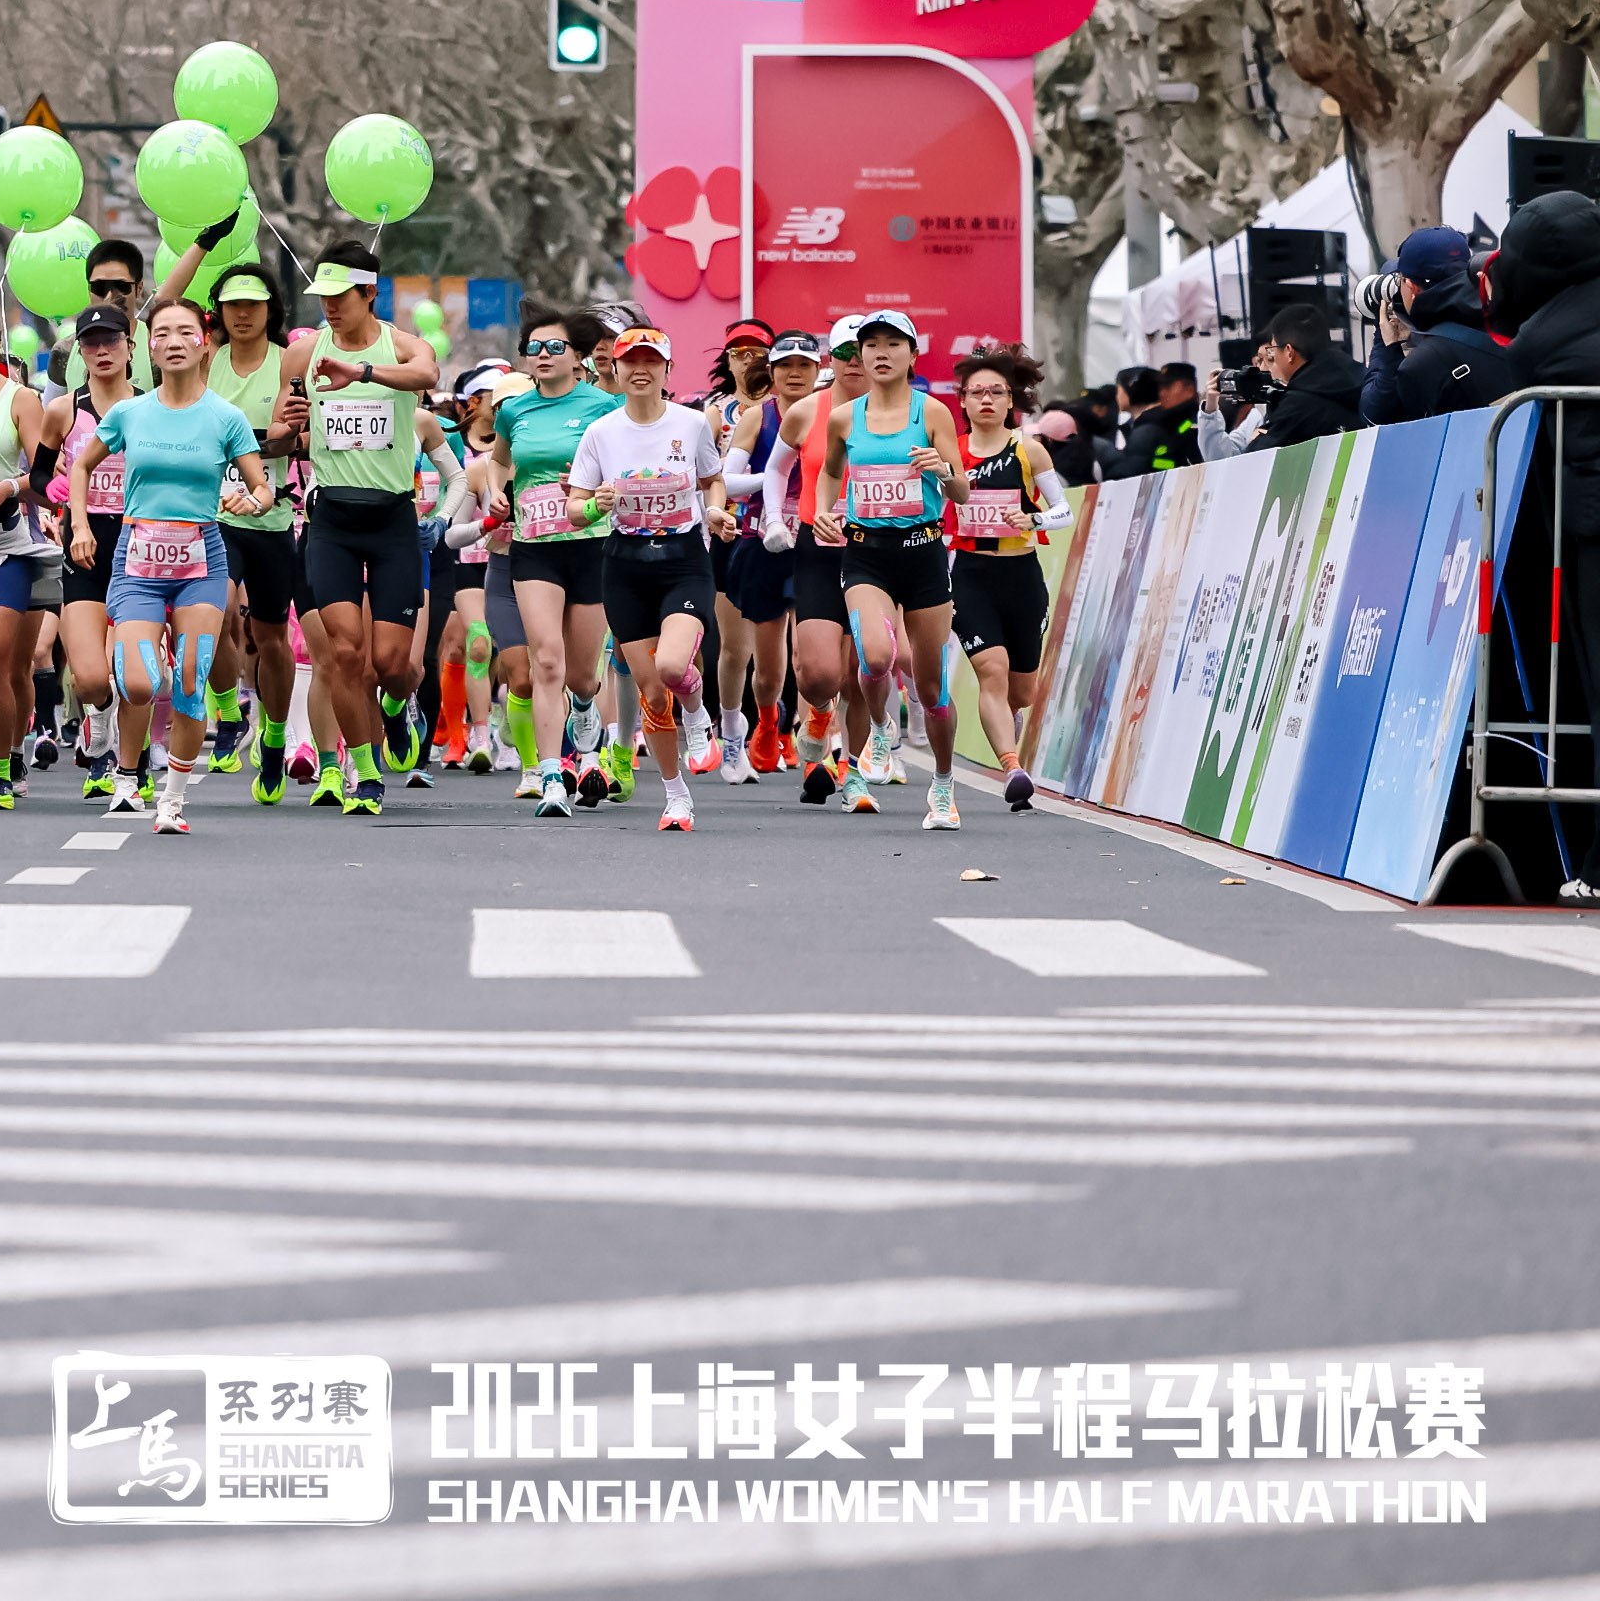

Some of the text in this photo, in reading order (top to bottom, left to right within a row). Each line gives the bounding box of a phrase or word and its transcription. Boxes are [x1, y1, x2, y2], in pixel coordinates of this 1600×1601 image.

[757, 249, 856, 263] new balance
[326, 417, 388, 435] PACE 07
[138, 440, 202, 453] PIONEER CAMP
[862, 482, 906, 502] 1030
[529, 500, 567, 522] 2197
[634, 495, 676, 512] 1753
[144, 543, 190, 564] 1095
